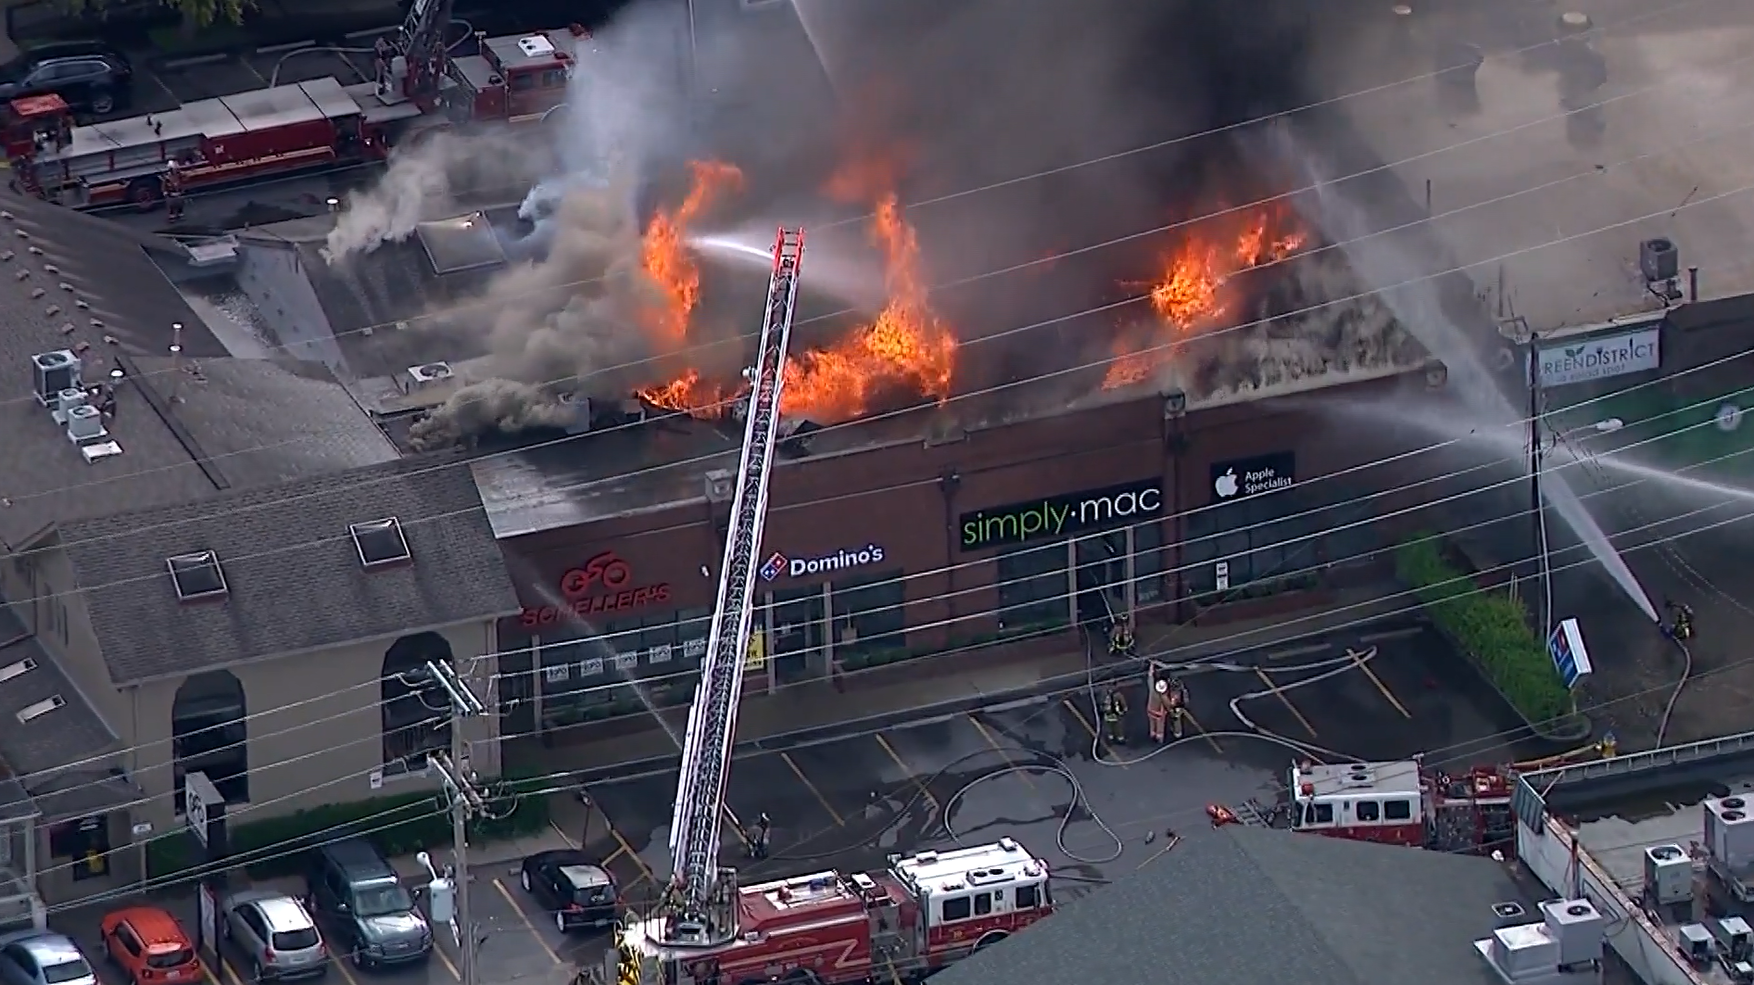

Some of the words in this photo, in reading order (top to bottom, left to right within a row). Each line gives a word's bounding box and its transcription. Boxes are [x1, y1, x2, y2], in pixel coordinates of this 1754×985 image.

[1245, 467, 1275, 483] Apple
[1245, 477, 1292, 494] Specialist
[790, 544, 883, 577] Domino's
